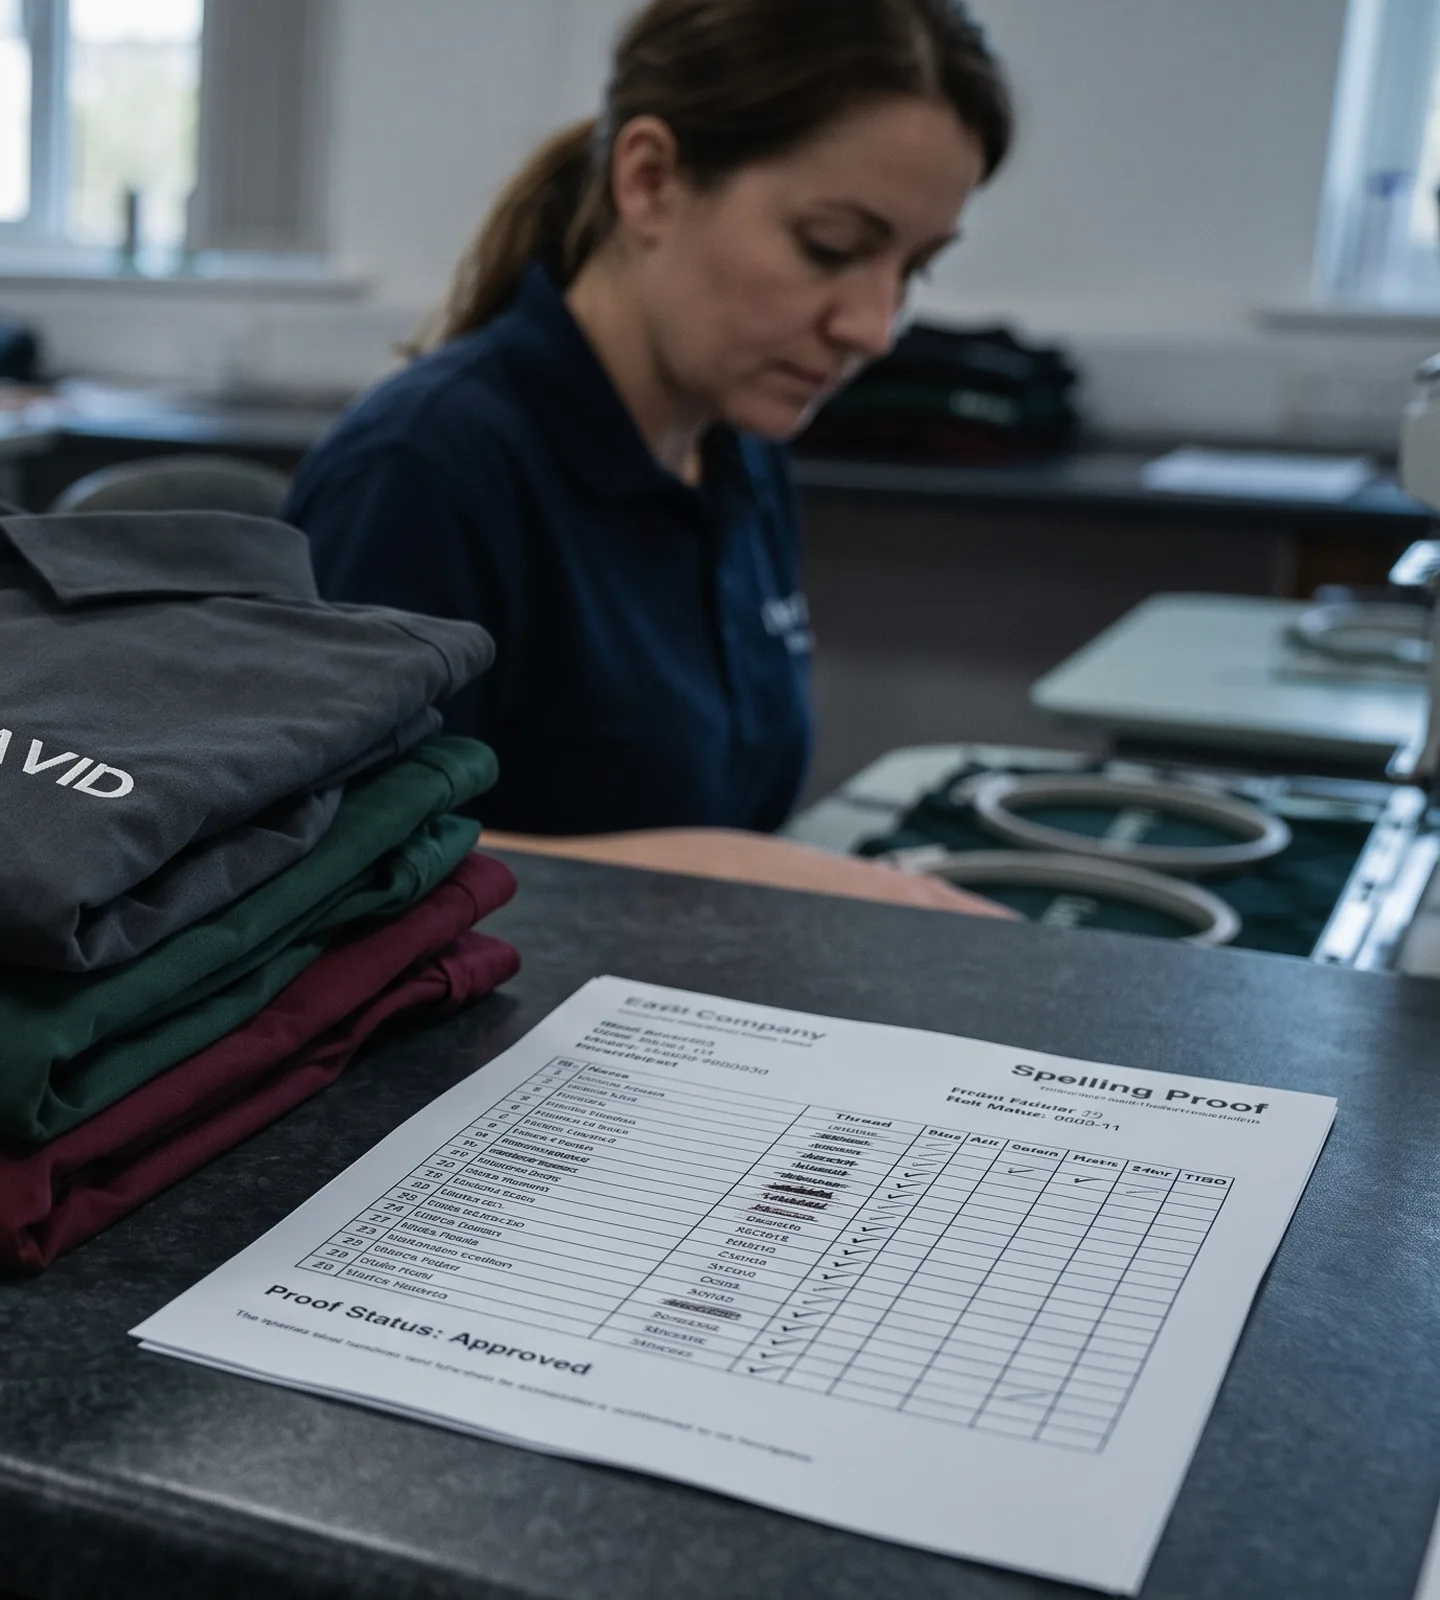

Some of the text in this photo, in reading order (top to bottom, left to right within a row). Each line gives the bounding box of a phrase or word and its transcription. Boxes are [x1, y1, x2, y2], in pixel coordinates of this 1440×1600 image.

[1010, 1063, 1153, 1099] Spelling
[1164, 1088, 1269, 1116] Proof
[263, 1283, 344, 1313] Proof
[345, 1304, 443, 1340] Status:
[449, 1331, 594, 1376] Approved
